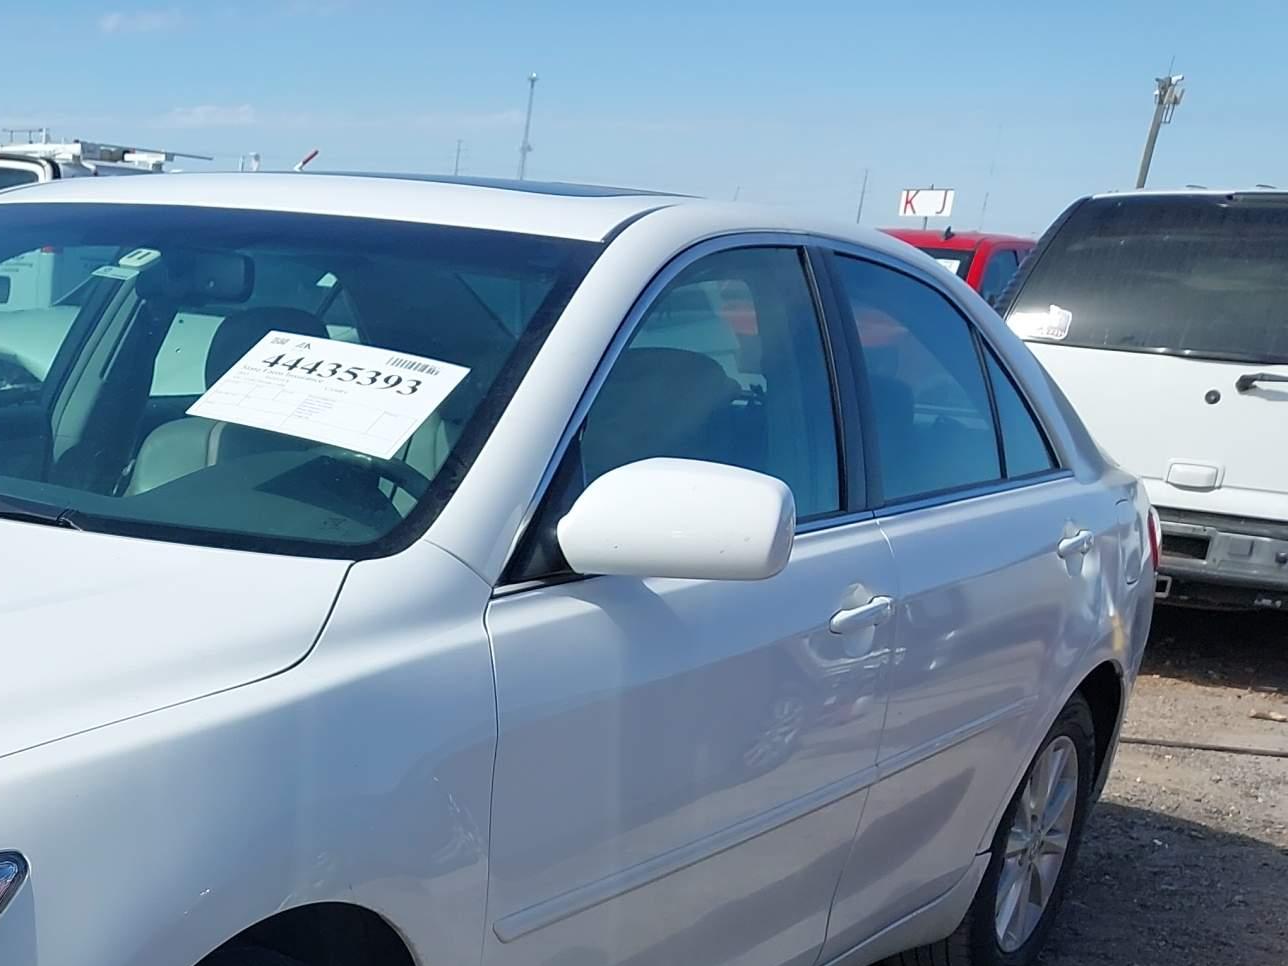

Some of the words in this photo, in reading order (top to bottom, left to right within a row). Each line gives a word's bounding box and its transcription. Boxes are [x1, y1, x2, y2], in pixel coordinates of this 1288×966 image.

[903, 189, 919, 214] K
[935, 190, 948, 215] J
[262, 353, 422, 396] 44435393
